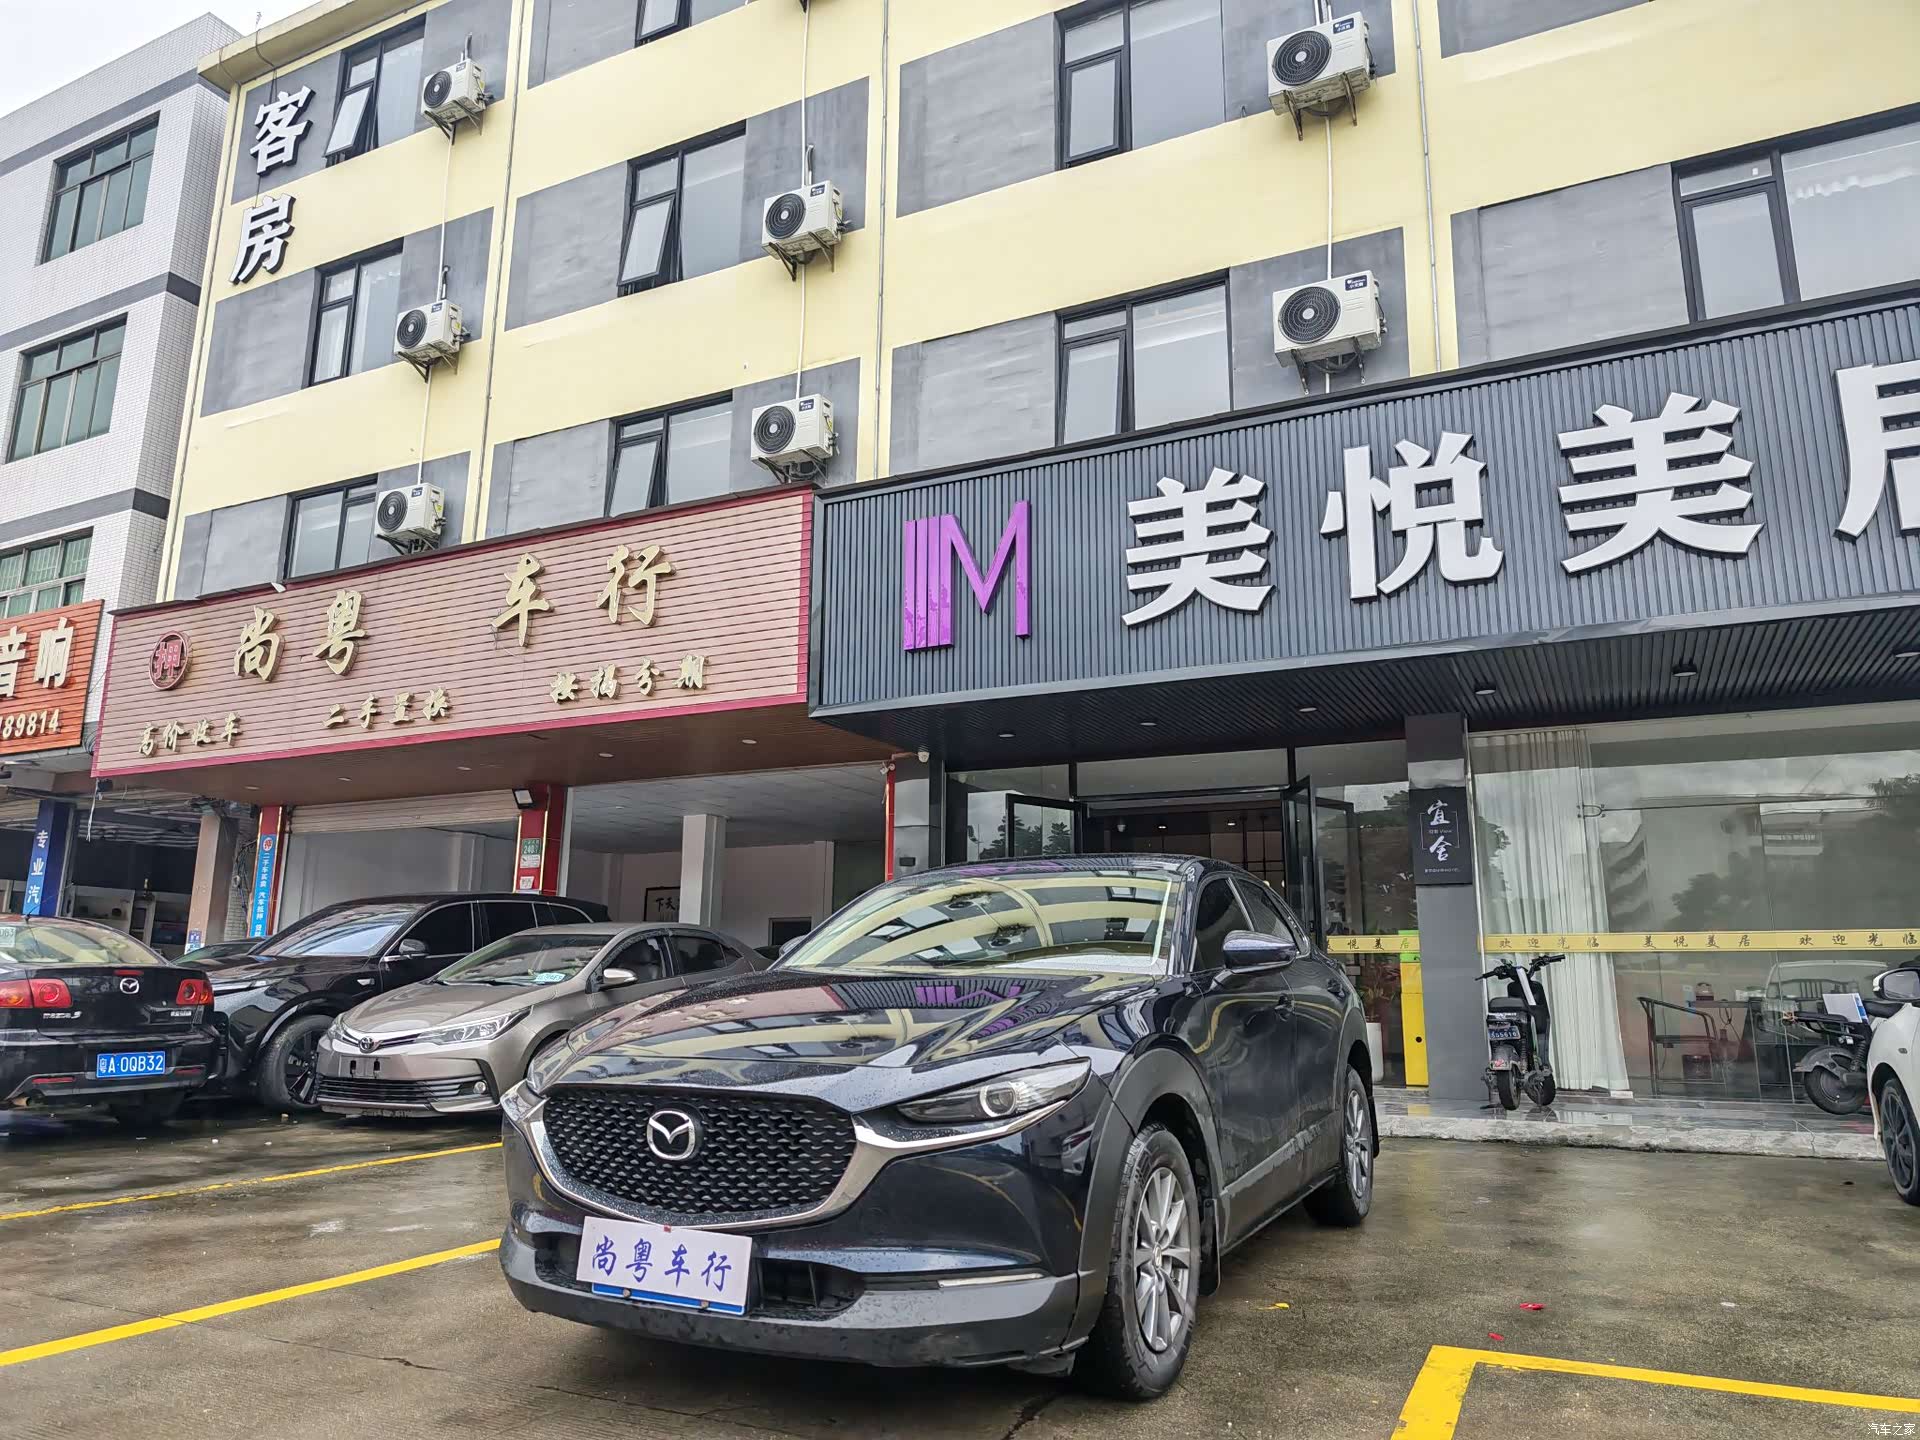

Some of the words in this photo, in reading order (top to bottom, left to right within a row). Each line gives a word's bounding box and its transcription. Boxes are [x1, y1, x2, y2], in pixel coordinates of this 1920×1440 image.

[228, 85, 316, 285] 客房
[550, 654, 710, 704] 按揭分期
[0, 708, 60, 740] 89814
[322, 687, 452, 729] 二手置换
[139, 712, 243, 758] 高价收车
[27, 830, 49, 904] 专业汽
[1499, 935, 1600, 950] 欢迎光临
[1643, 934, 1752, 949] 美悦美居
[1799, 932, 1920, 947] 欢迎光临
[590, 1235, 733, 1293] 尚粤车行
